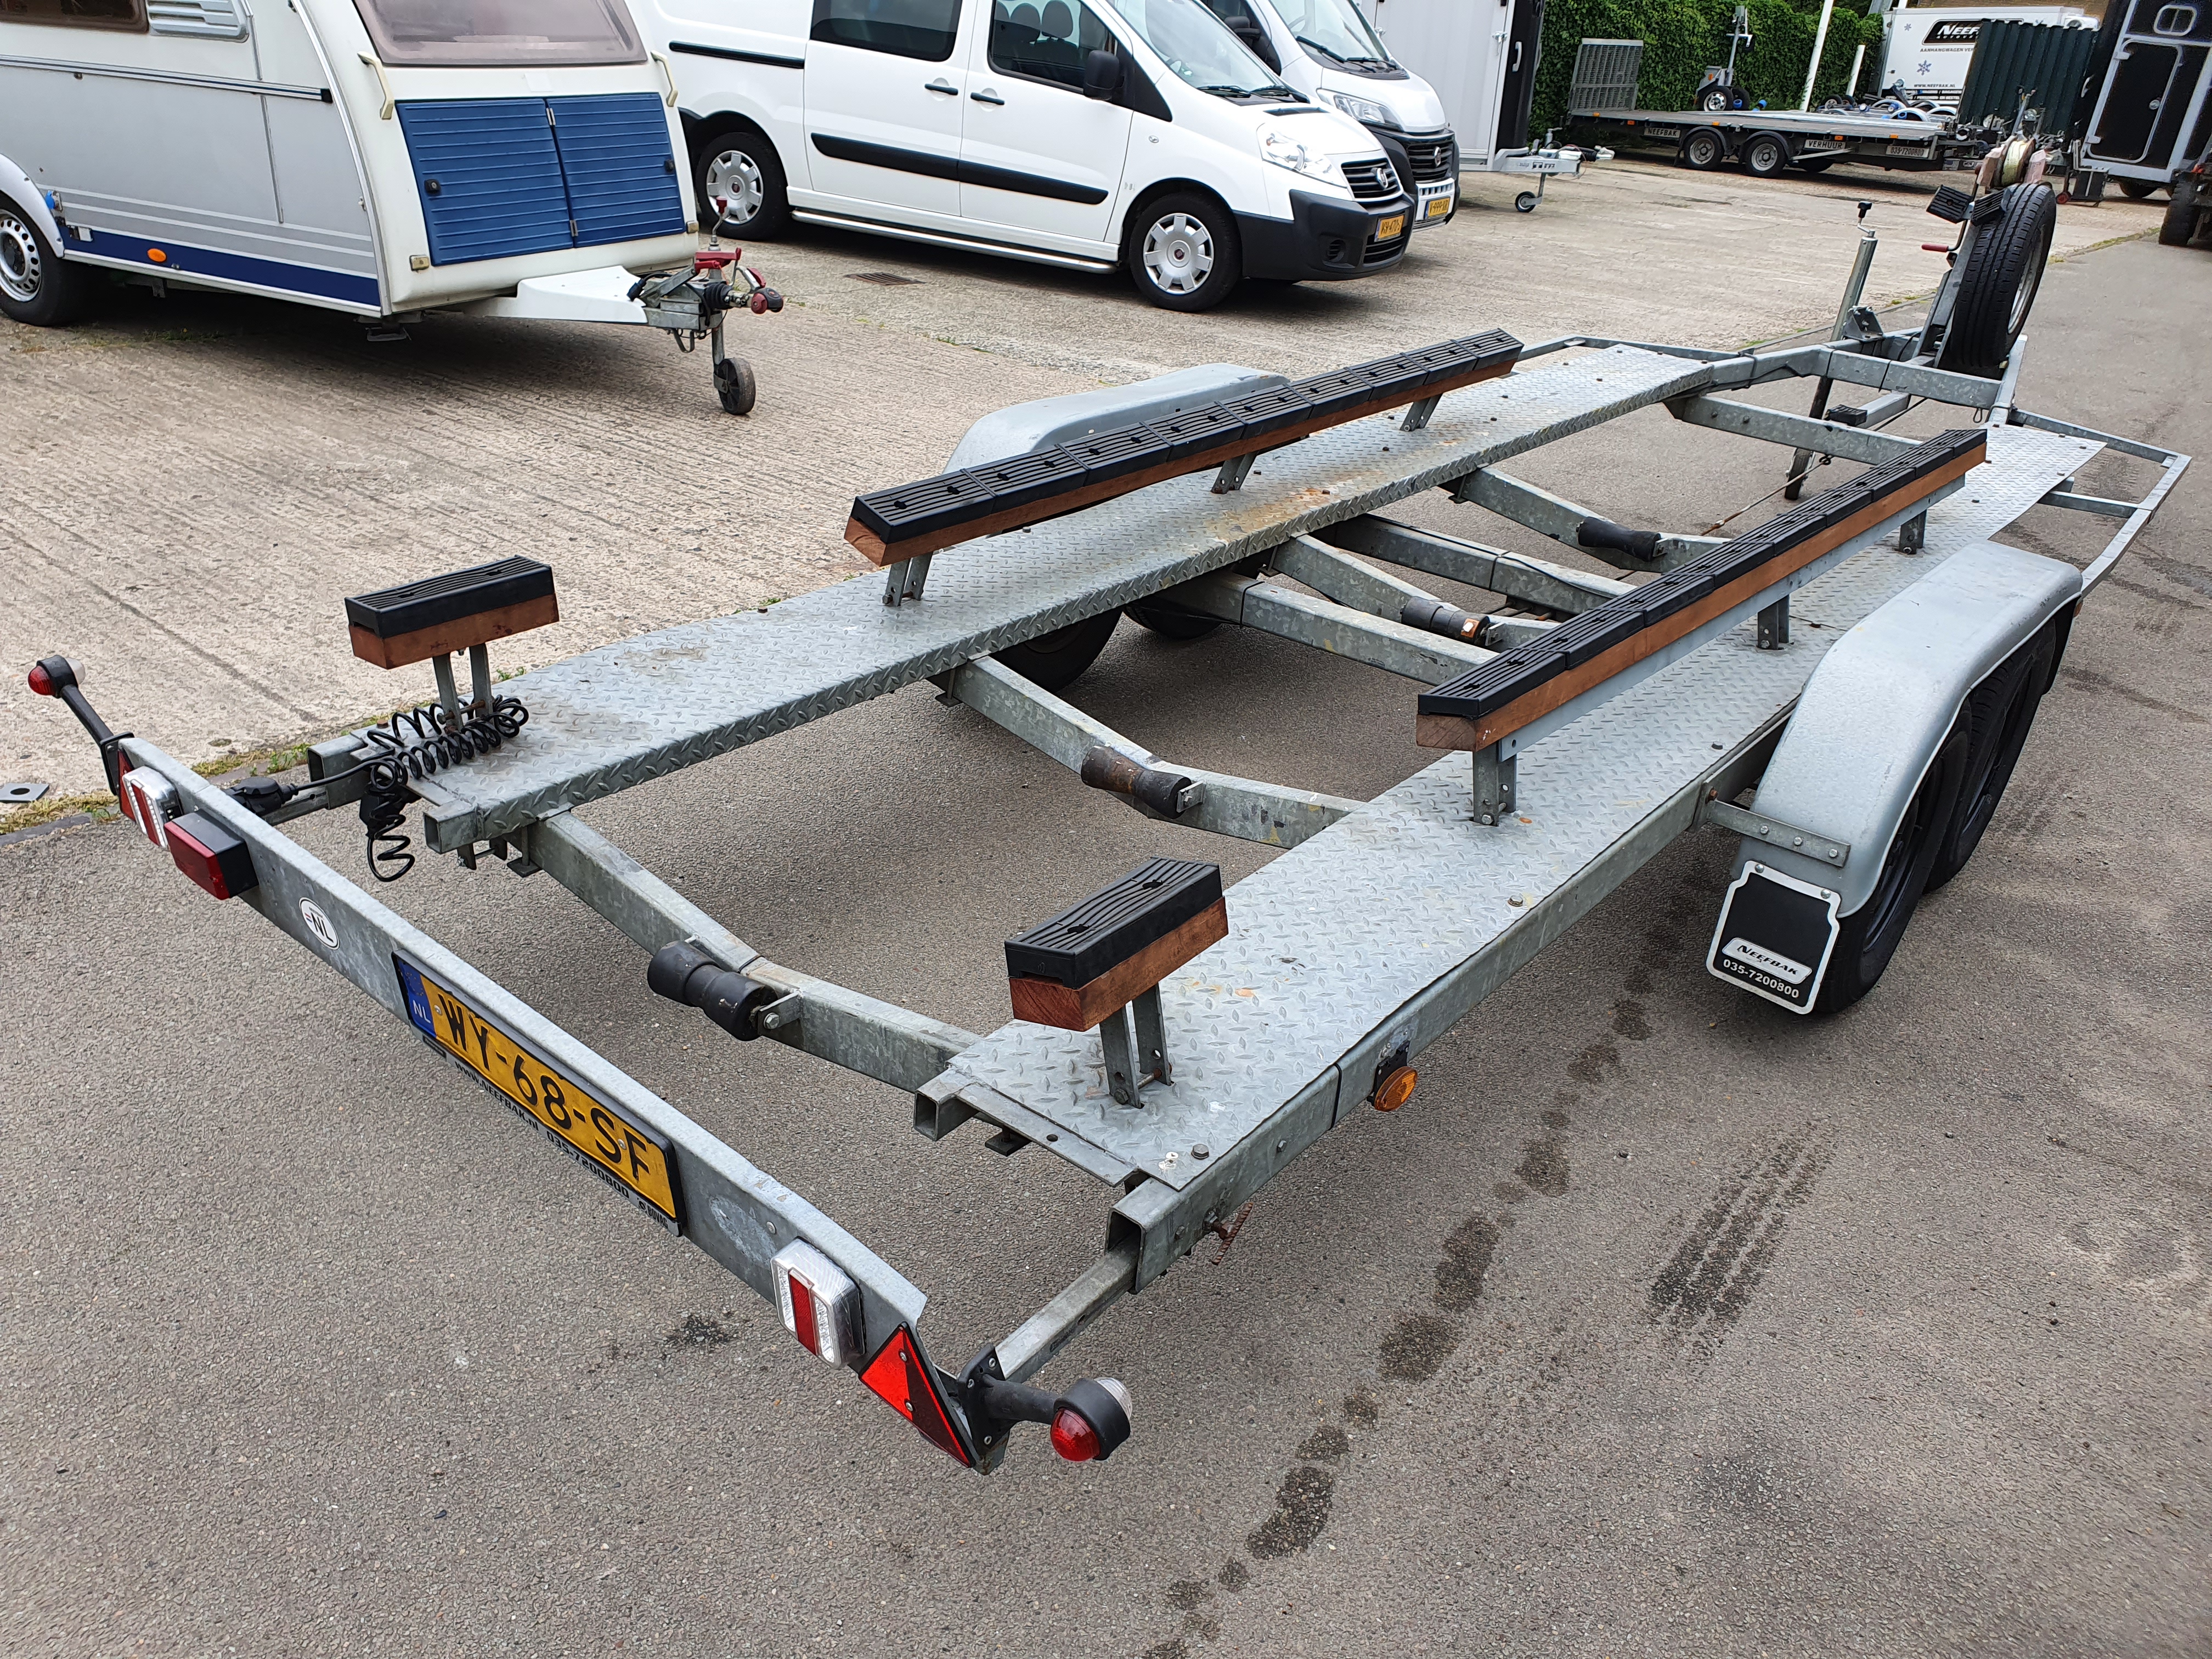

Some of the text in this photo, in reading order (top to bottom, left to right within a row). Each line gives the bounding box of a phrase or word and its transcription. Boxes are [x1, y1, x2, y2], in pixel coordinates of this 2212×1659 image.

[1648, 128, 1677, 137] NEEFBAK
[1809, 140, 1843, 149] VERHUUR
[311, 912, 334, 944] NL
[1737, 945, 1799, 975] NEEFBAK
[1723, 959, 1799, 998] 035-7200800
[413, 1000, 431, 1024] NL
[438, 994, 650, 1181] WY-68-SF
[455, 1061, 668, 1229] www.NEEFBAK.nl 035-7200800 BOVAG
